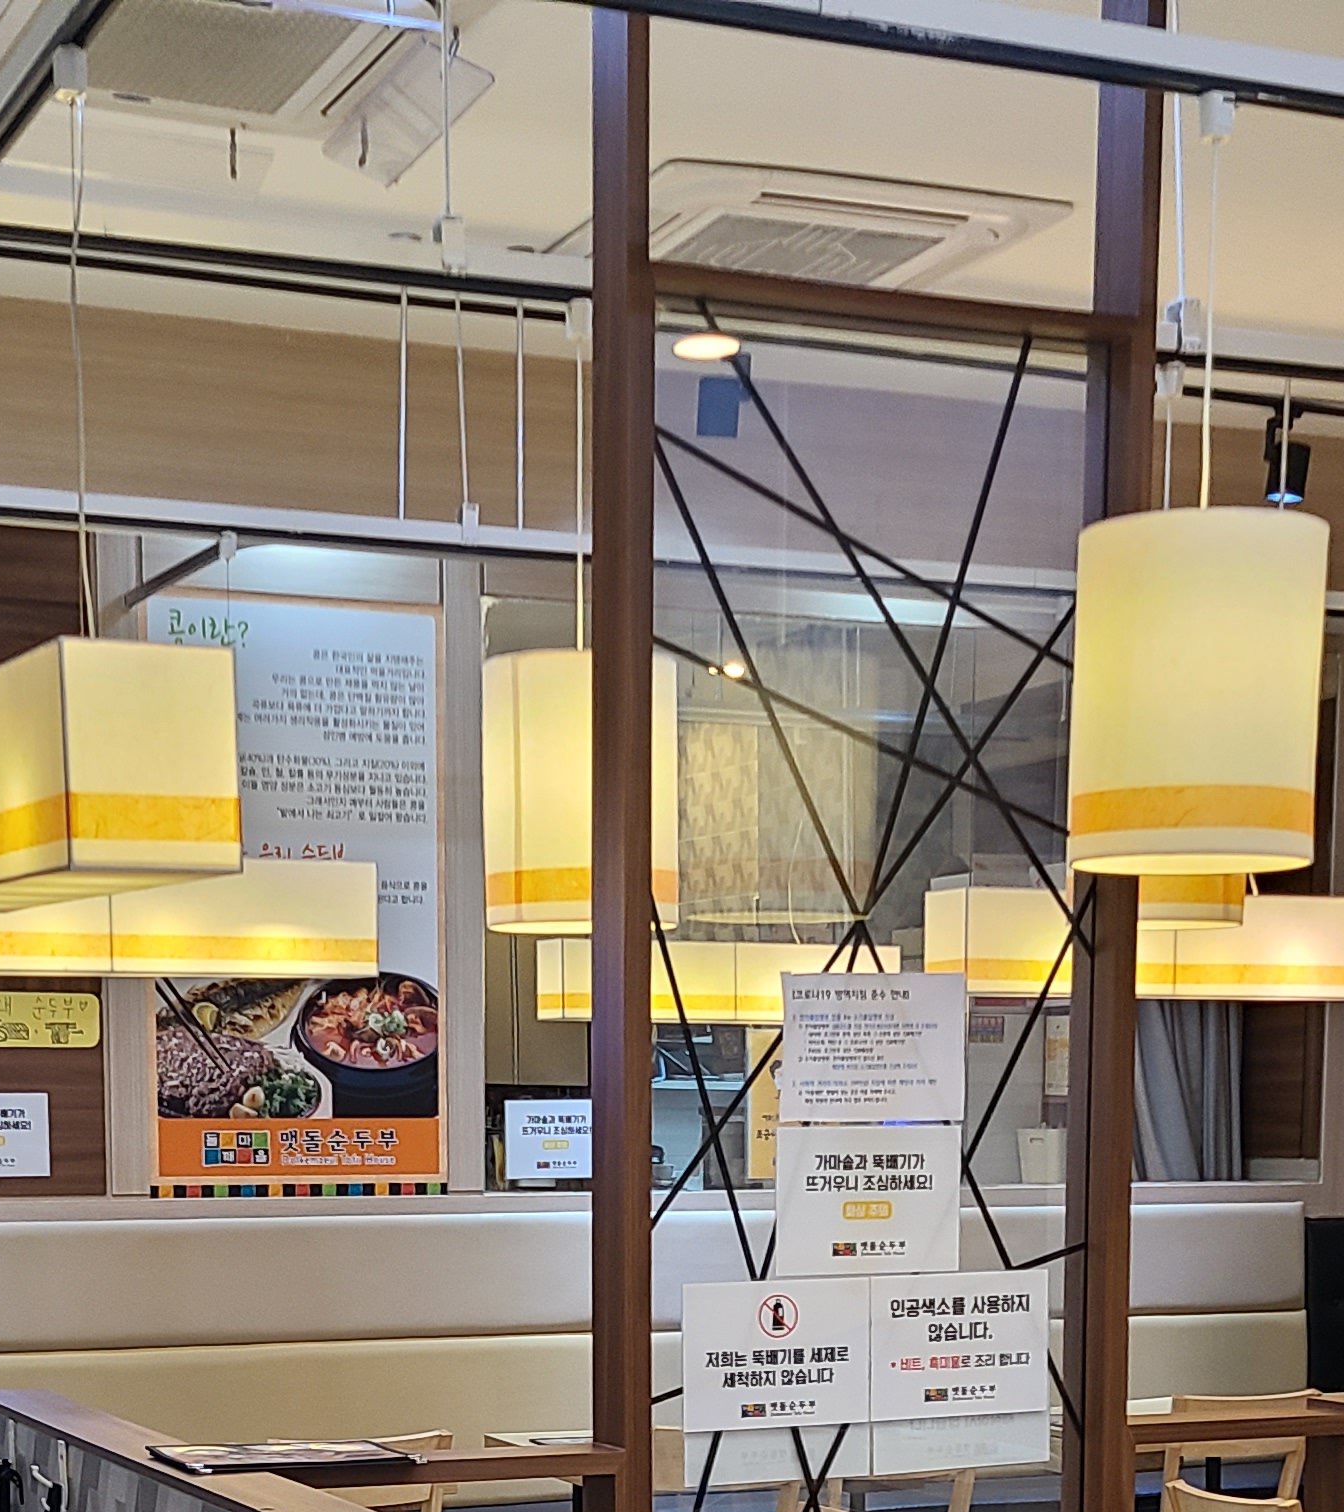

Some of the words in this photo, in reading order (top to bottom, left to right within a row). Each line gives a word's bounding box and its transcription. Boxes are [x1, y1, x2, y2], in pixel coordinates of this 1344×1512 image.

[280, 1130, 398, 1154] 맷돌순두부
[814, 1155, 868, 1171] 가마솥과
[873, 1153, 925, 1171] 뚝배기가
[805, 1176, 859, 1192] 뜨거우니
[863, 1174, 933, 1192] 조심하세요!
[891, 1297, 966, 1319] 인공색소를
[971, 1294, 1030, 1315] 사용하지
[928, 1322, 993, 1342] 않습니다.
[706, 1351, 748, 1368] 저희는
[752, 1349, 805, 1366] 뚝배기를
[810, 1347, 850, 1363] 세제로
[974, 1354, 996, 1367] 조리
[999, 1352, 1030, 1366] 합니다
[722, 1371, 777, 1389] 세척하지
[781, 1368, 834, 1386] 않습니다
